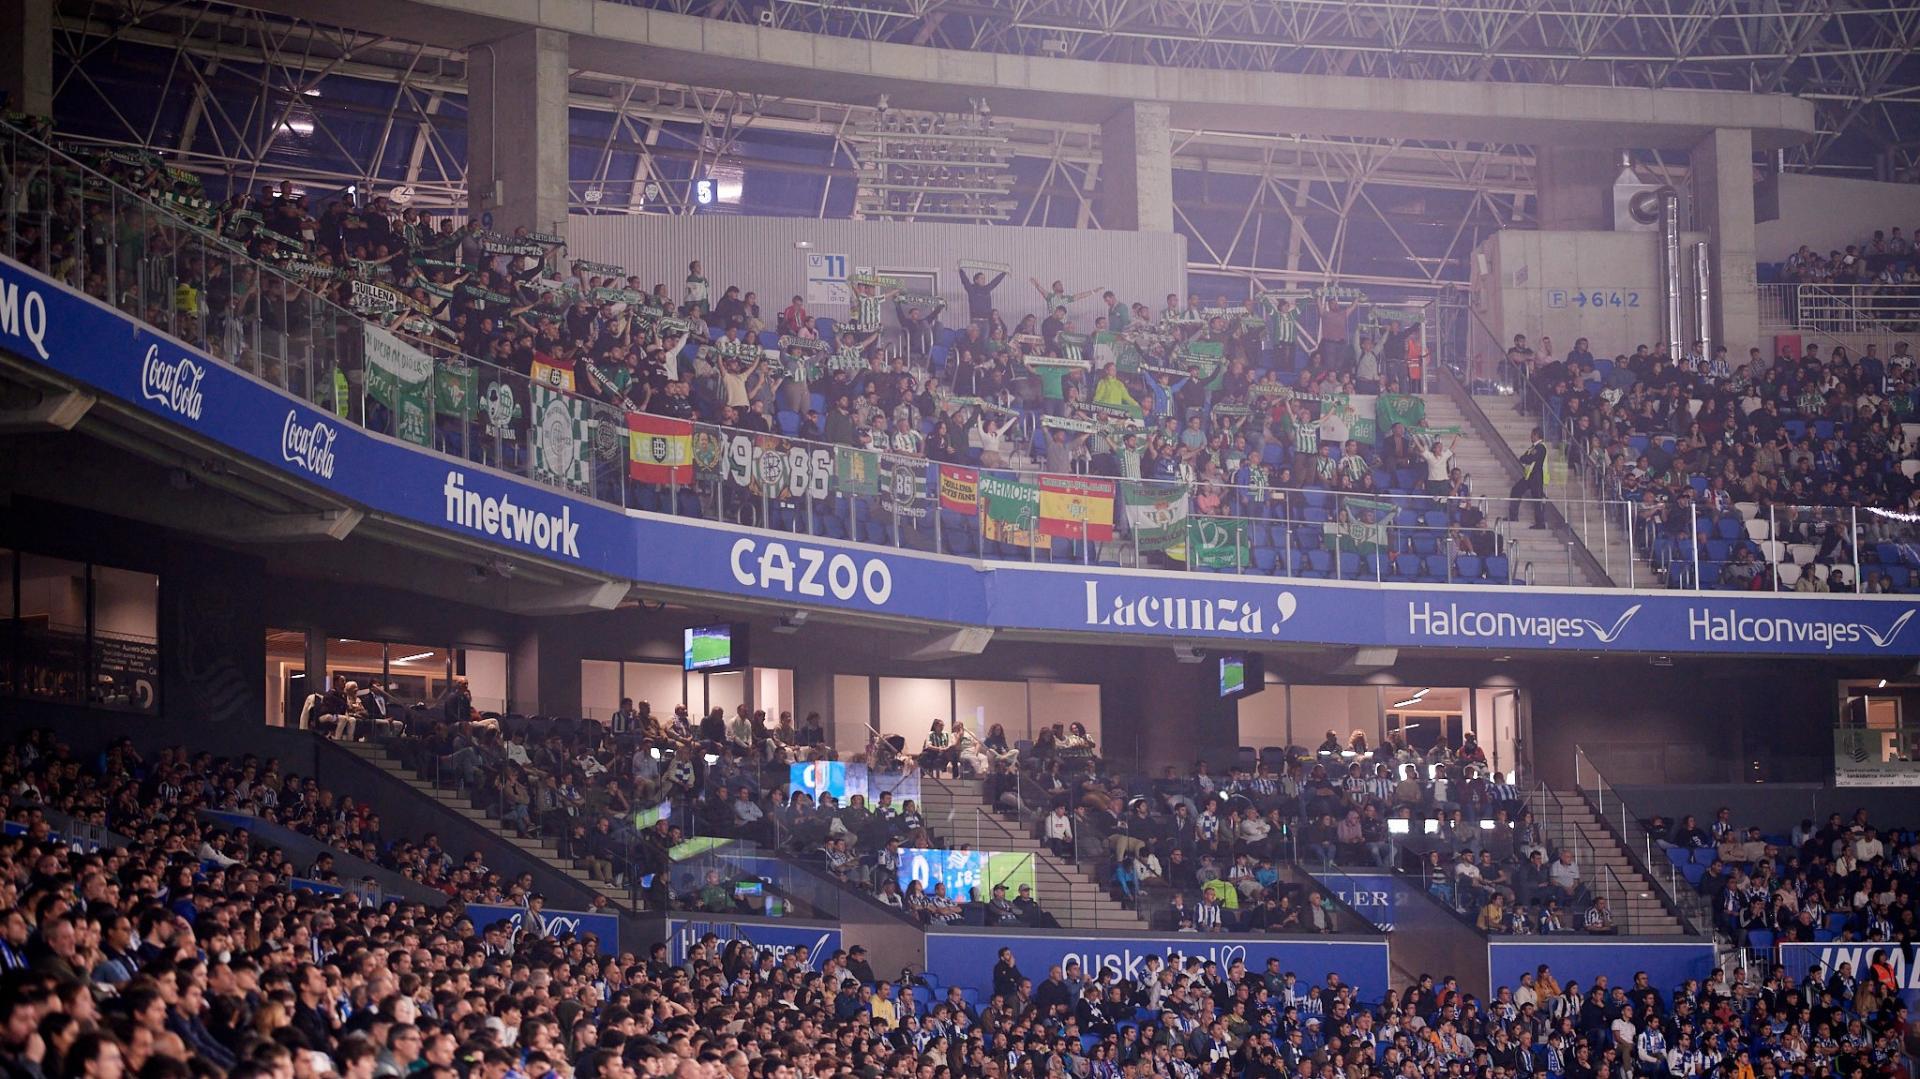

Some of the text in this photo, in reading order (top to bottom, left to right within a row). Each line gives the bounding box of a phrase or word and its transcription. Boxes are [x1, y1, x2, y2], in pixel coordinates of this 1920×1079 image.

[697, 180, 712, 204] 5
[824, 255, 845, 278] 11
[354, 281, 394, 303] GUILLENA
[1553, 292, 1563, 305] F
[1591, 291, 1640, 307] 642
[0, 279, 49, 359] MQ
[788, 447, 834, 500] 86
[444, 472, 580, 559] finetwork
[730, 538, 892, 605] CAZOO
[1085, 580, 1263, 634] Lacunza
